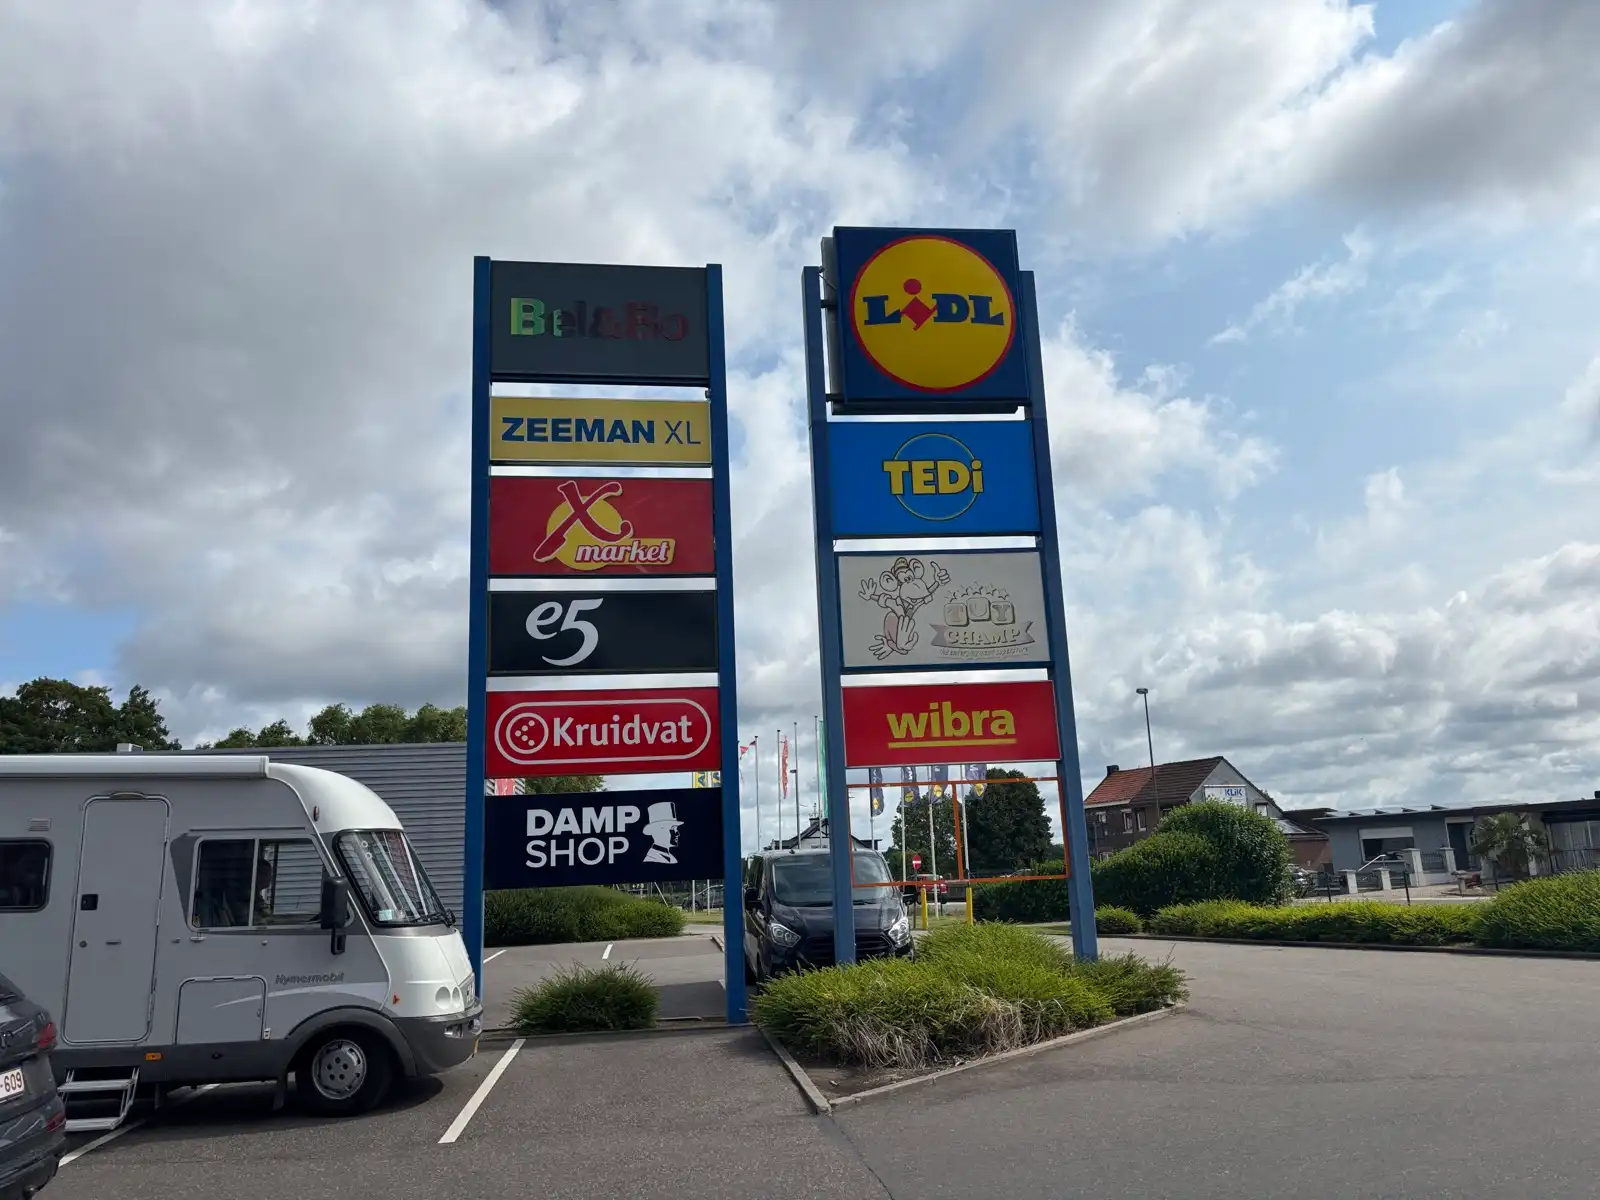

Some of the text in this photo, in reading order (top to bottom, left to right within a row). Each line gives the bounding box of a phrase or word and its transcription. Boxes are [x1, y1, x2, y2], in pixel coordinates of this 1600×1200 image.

[501, 417, 702, 445] ZEEMAN XL
[882, 459, 984, 496] TEDi
[532, 480, 634, 563] X
[575, 540, 671, 563] market
[525, 598, 604, 667] e5
[553, 714, 693, 747] Kruidvat
[886, 701, 1016, 739] wibra
[526, 805, 641, 836] DAMP
[525, 836, 630, 868] SHOP
